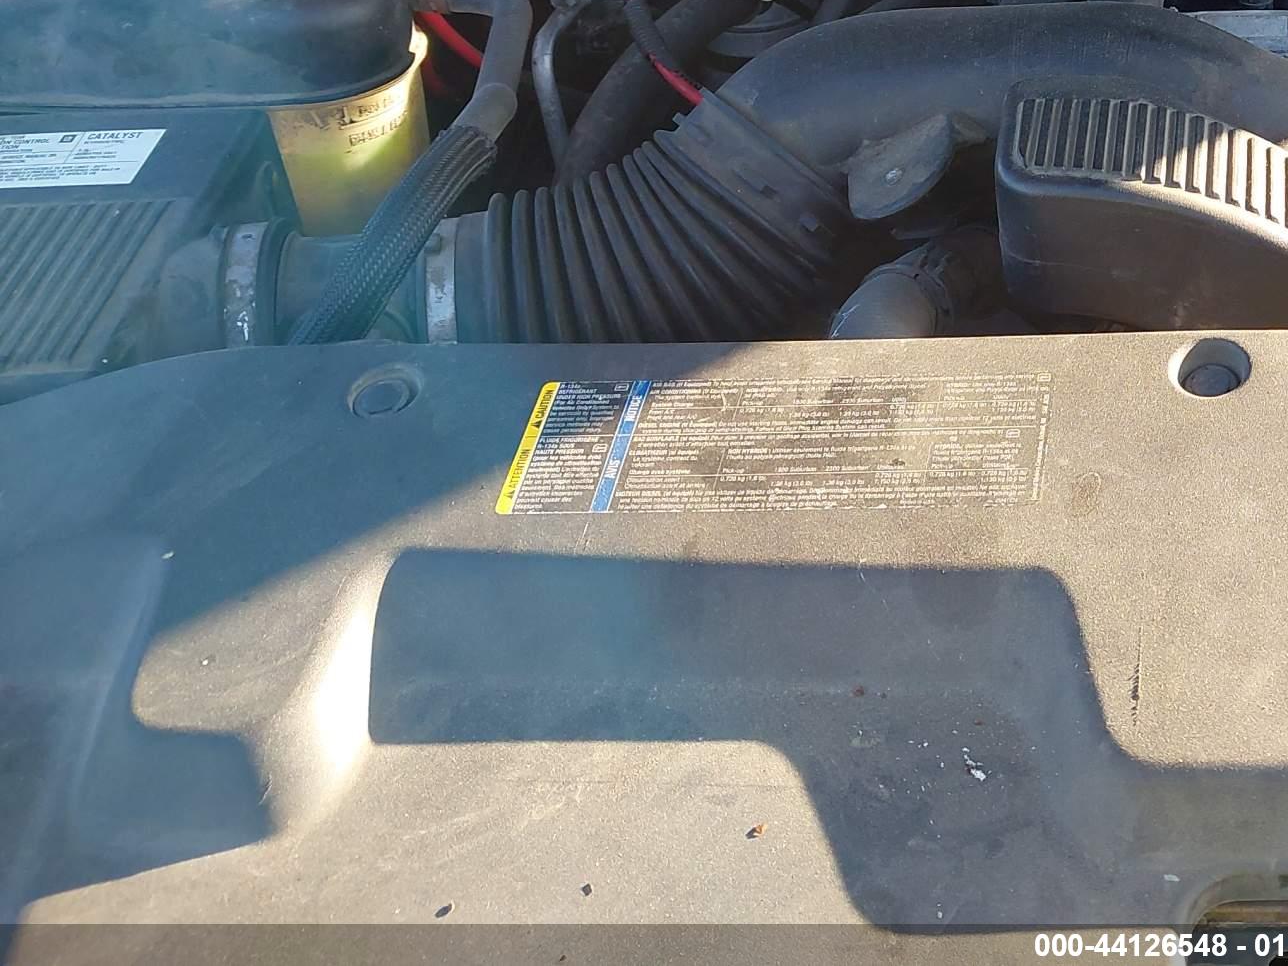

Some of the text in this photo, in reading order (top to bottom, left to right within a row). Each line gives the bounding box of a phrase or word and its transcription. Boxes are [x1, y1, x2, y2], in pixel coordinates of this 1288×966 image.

[87, 131, 143, 140] CATALYST
[535, 389, 555, 419] CAUTION
[624, 395, 643, 422] NOTICE
[508, 448, 531, 491] ATTENTION
[604, 459, 620, 479] AVIS
